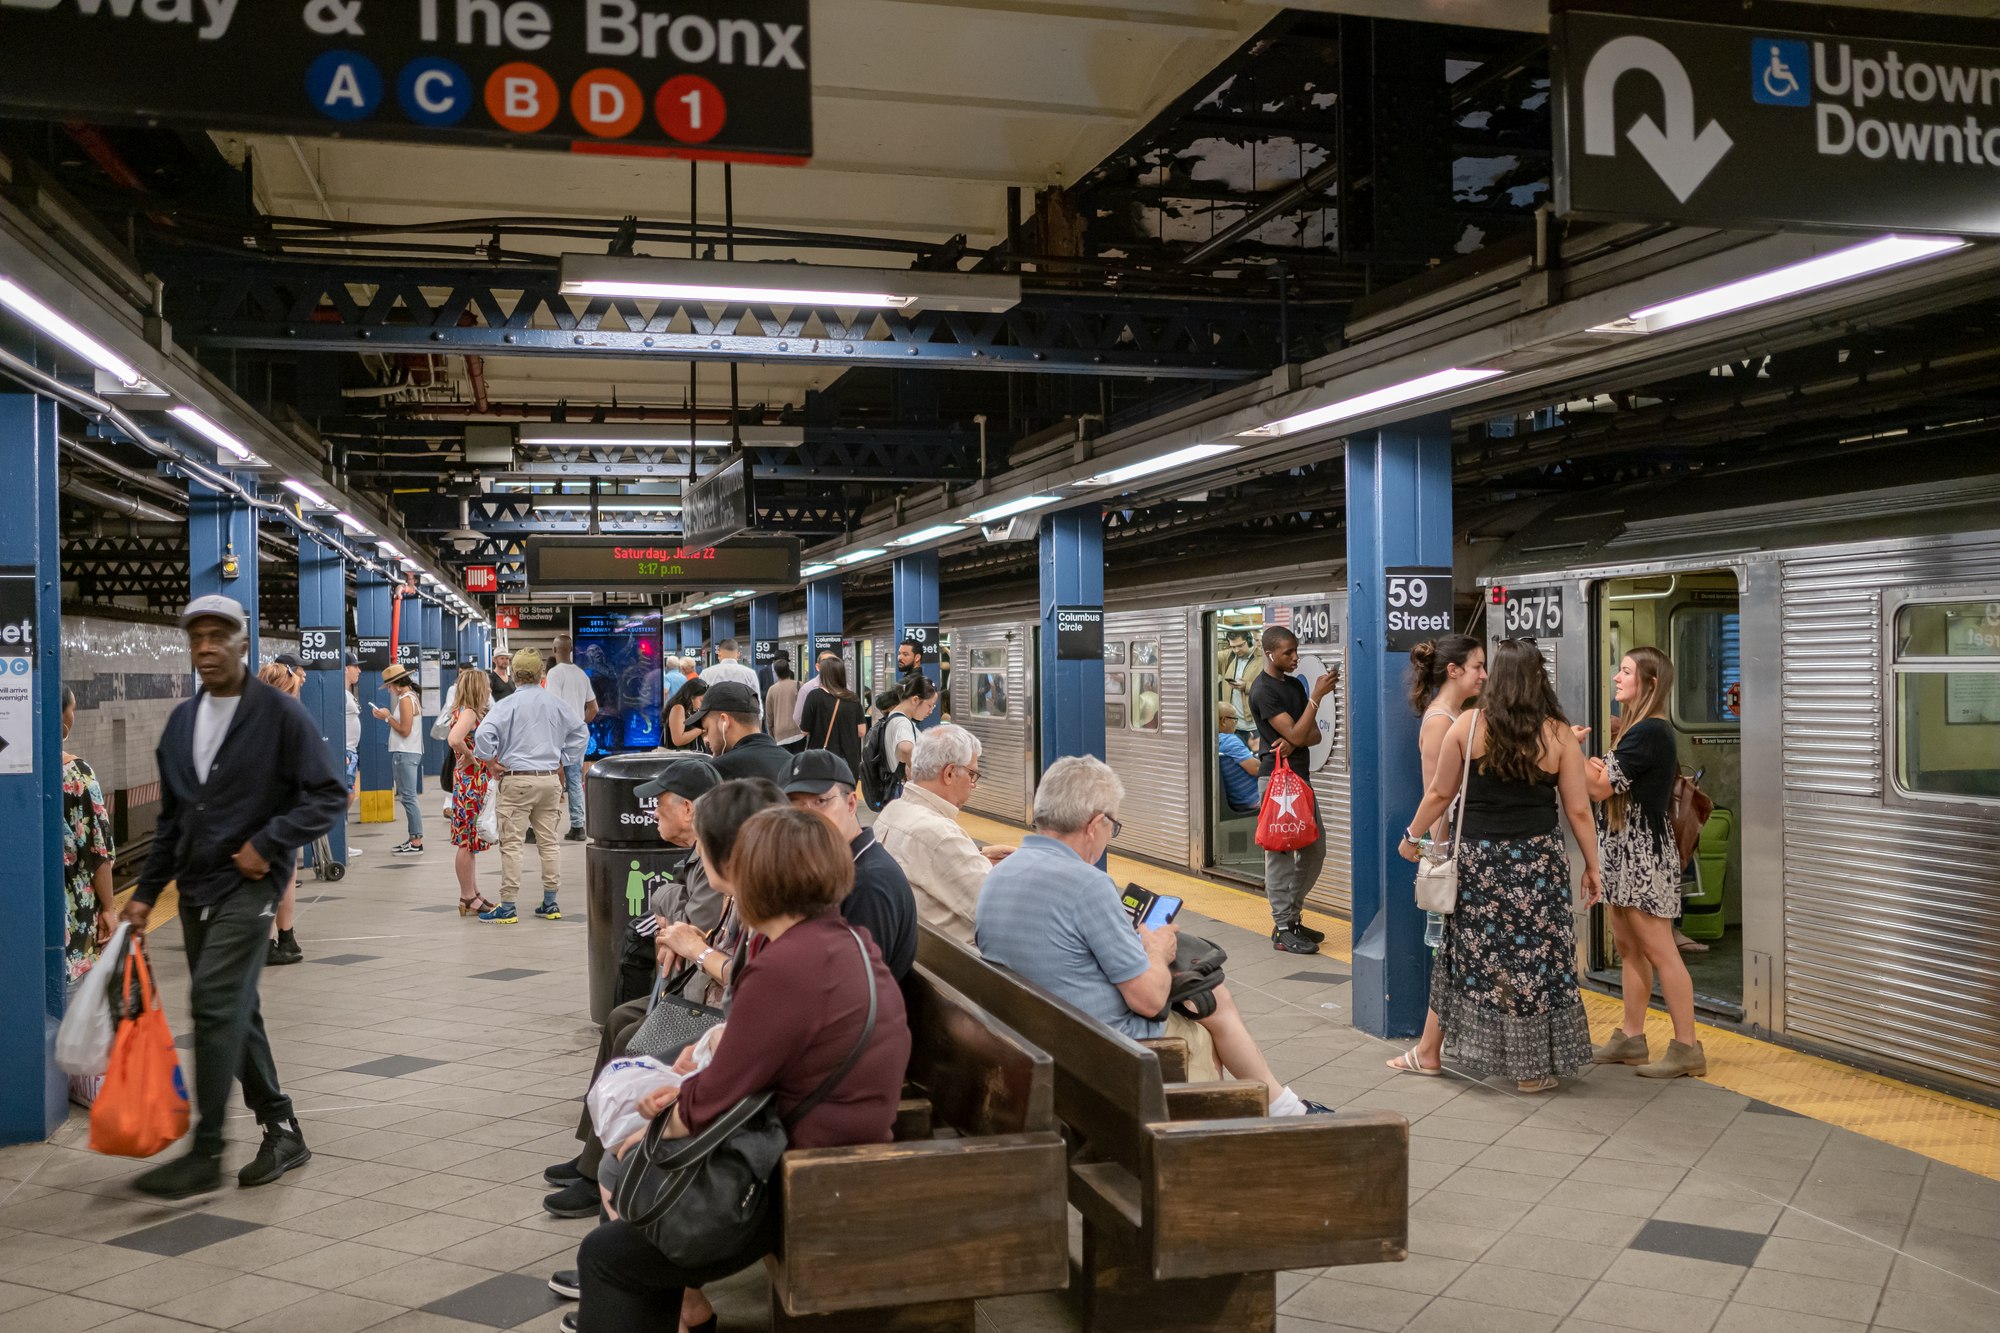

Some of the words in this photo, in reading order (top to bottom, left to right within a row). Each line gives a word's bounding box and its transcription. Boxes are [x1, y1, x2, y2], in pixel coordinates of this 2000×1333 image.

[586, 0, 807, 70] Bronx
[1814, 42, 2000, 108] Uptown
[324, 65, 365, 107] A
[413, 70, 455, 114] C
[504, 77, 540, 118] B
[589, 83, 626, 123] D
[680, 90, 702, 129] 1
[614, 547, 670, 562] Saturday,
[703, 548, 715, 559] 22
[638, 563, 658, 574] 3:17
[660, 565, 684, 577] p.m.
[1388, 578, 1428, 608] 59
[497, 607, 517, 615] Exit
[519, 606, 530, 614] 60
[531, 606, 553, 614] Street
[519, 613, 553, 621] Broadway
[1058, 612, 1100, 622] Columbus
[1506, 596, 1561, 631] 3575
[1058, 622, 1083, 632] Circle
[1294, 611, 1329, 639] 3419
[1388, 610, 1450, 631] Street
[0, 619, 33, 643] et
[905, 628, 926, 642] 59
[302, 632, 326, 648] 59
[755, 642, 771, 652] 59
[302, 648, 340, 660] Street
[685, 648, 696, 656] 59
[14, 661, 24, 672] C
[1320, 719, 1331, 732] City
